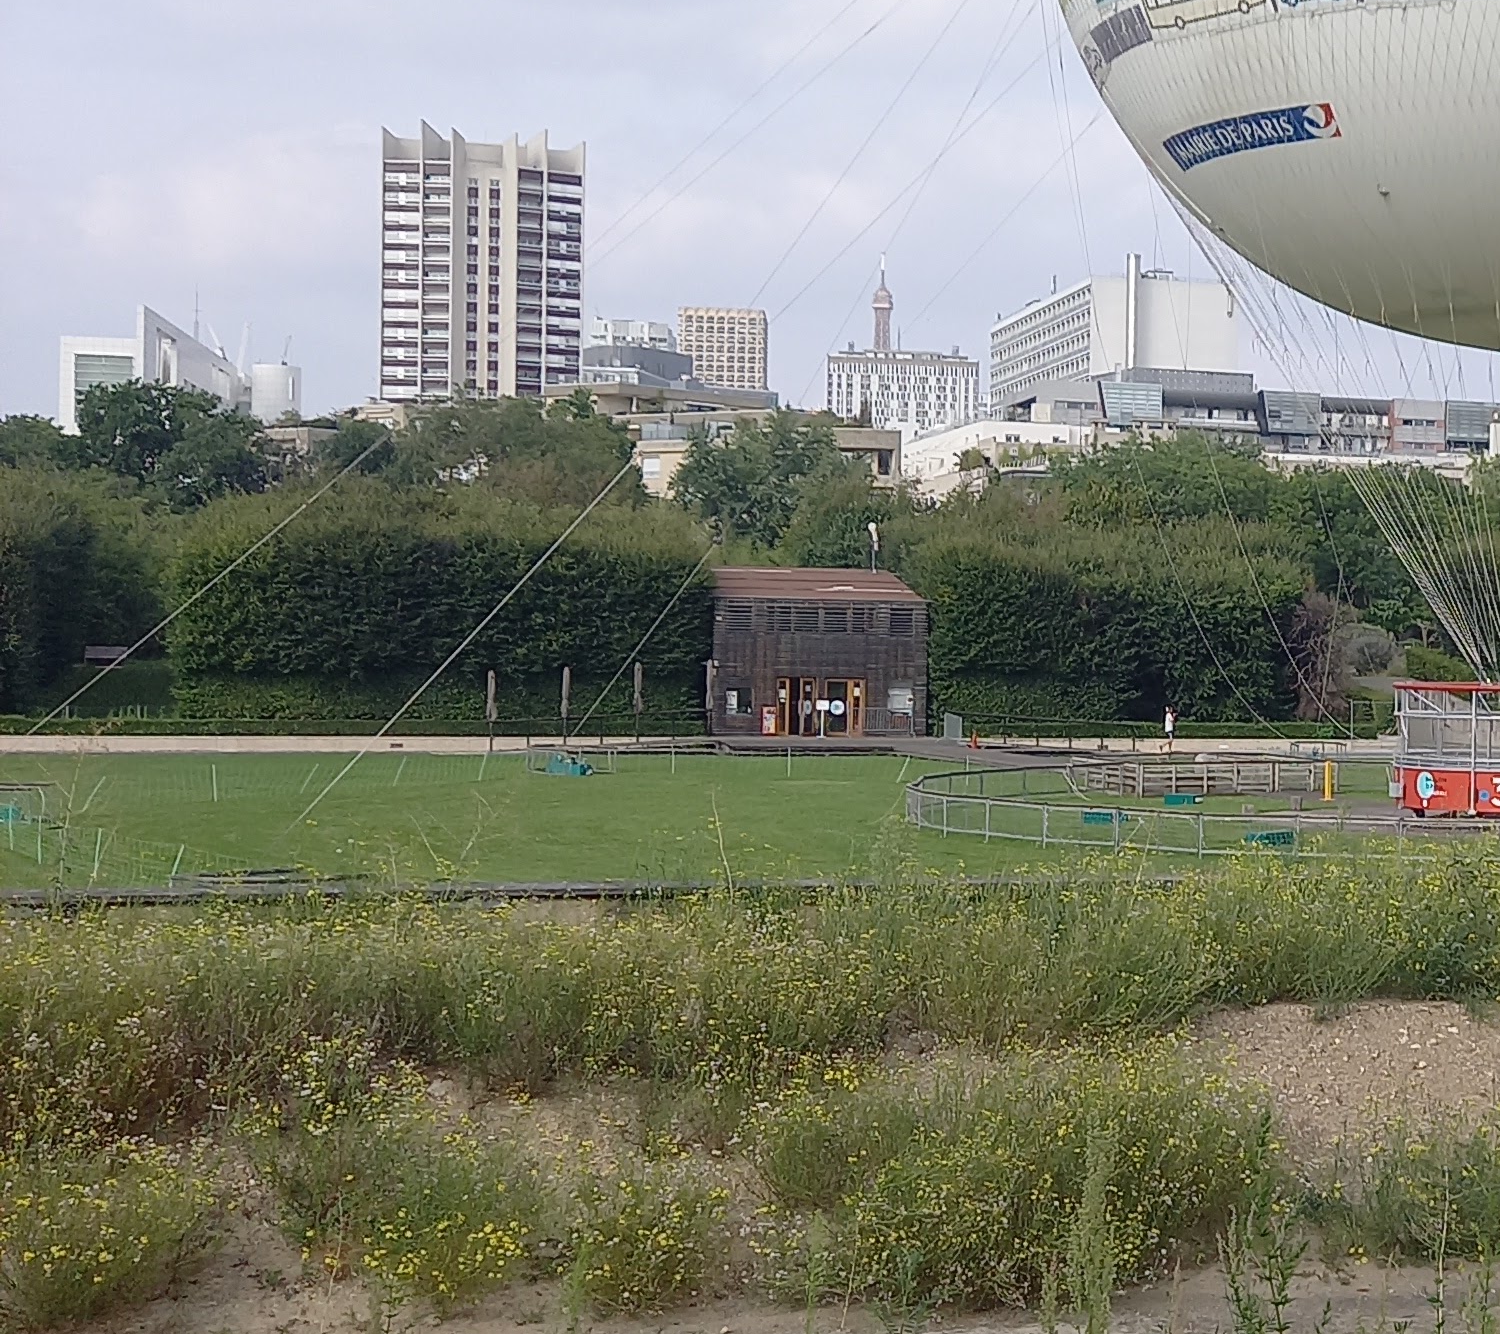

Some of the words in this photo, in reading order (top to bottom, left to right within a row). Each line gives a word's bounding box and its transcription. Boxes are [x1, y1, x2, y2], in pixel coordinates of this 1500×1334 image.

[1174, 130, 1220, 161] MAIRIE
[1216, 124, 1241, 147] DE
[1241, 116, 1295, 143] PARIS
